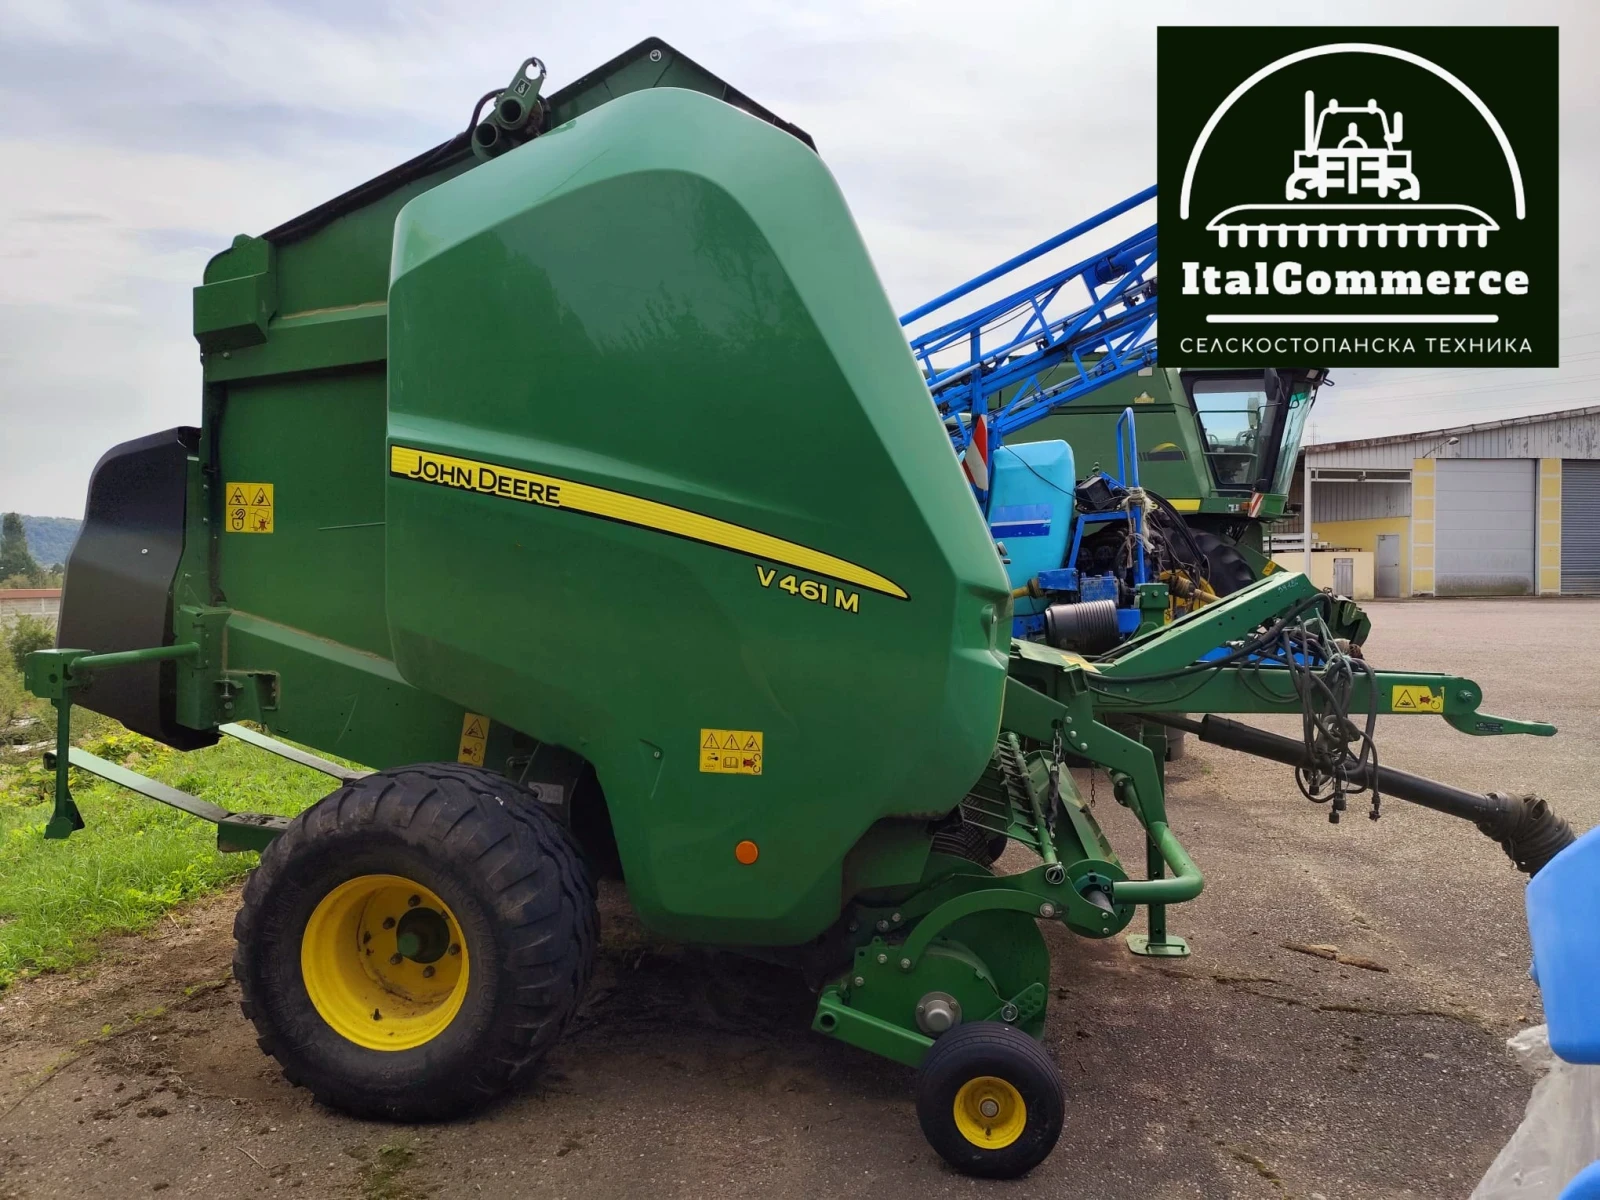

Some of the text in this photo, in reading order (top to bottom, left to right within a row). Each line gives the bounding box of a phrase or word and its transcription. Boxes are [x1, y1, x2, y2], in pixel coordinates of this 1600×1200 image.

[409, 455, 561, 505] JOHN DEERE
[755, 564, 860, 614] V 461 M
